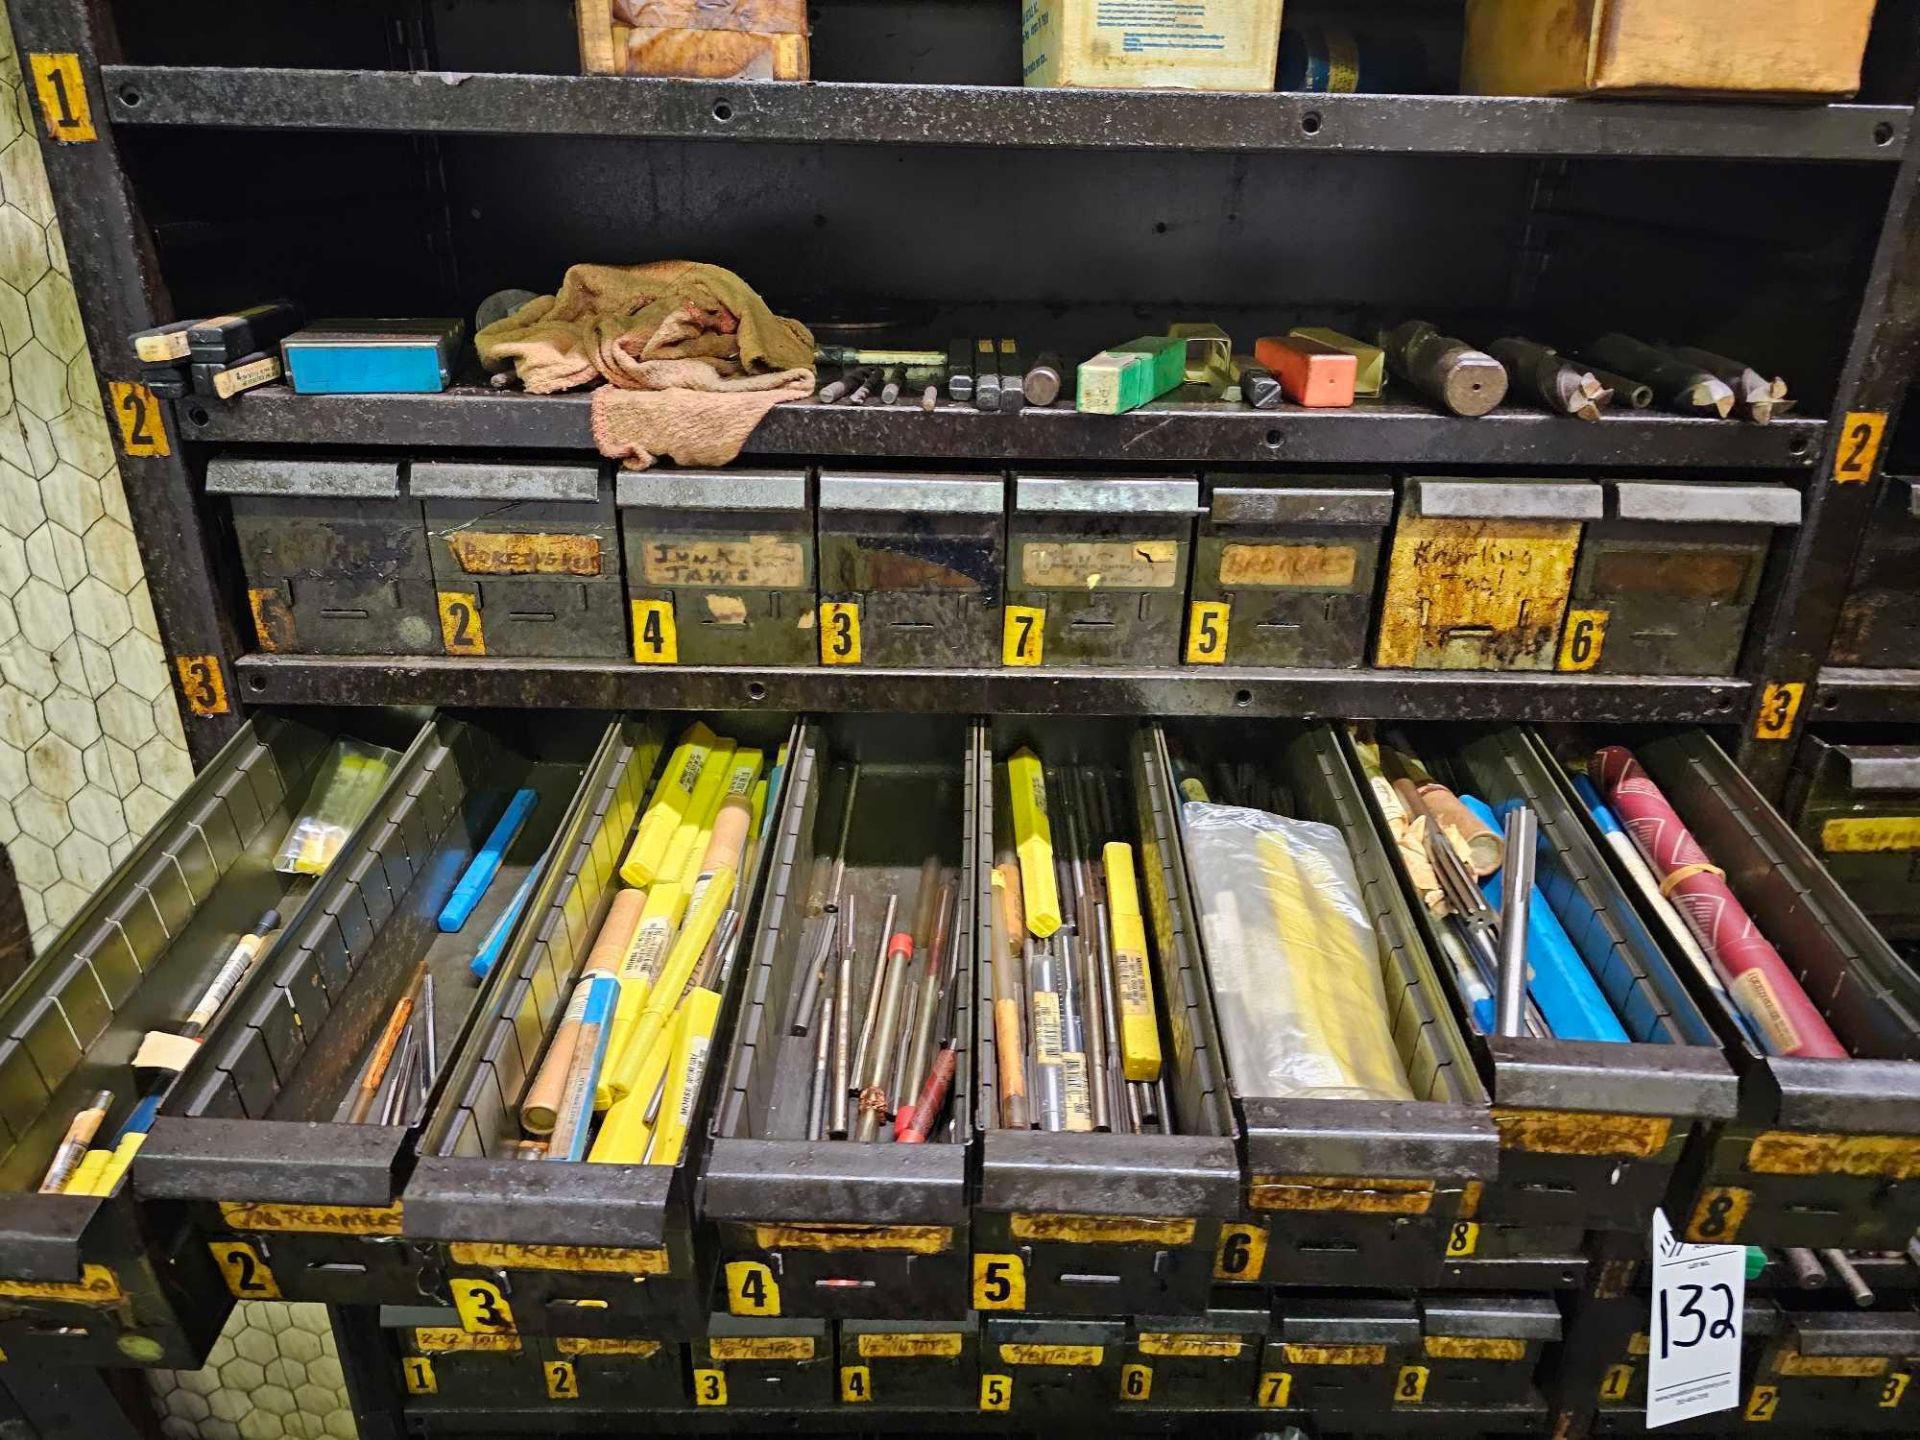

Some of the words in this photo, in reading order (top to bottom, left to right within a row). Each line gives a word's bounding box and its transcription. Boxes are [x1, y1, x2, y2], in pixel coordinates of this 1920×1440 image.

[46, 68, 80, 128] 1
[123, 391, 154, 445] 2
[1840, 423, 1872, 472] 2
[449, 603, 474, 646] 2
[643, 610, 664, 653] 4
[832, 613, 853, 656] 3
[1015, 616, 1034, 657] 7
[1199, 612, 1218, 653] 5
[1571, 620, 1592, 663] 6
[191, 663, 216, 707] 3
[1765, 689, 1793, 731] 3
[1699, 1196, 1733, 1237] 8
[1223, 1233, 1250, 1273] 6
[1451, 1223, 1468, 1251] 8
[228, 1251, 266, 1290] 2
[741, 1270, 767, 1307] 4
[984, 1263, 1011, 1301] 5
[470, 1288, 503, 1326] 3
[1660, 1283, 1736, 1359] 132
[412, 1364, 429, 1389] 1
[553, 1367, 570, 1392] 2
[704, 1376, 719, 1400] 3
[850, 1373, 864, 1396] 4
[988, 1380, 1003, 1405] 5
[1128, 1371, 1144, 1395] 6
[1268, 1378, 1283, 1402] 7
[1402, 1372, 1418, 1397] 8
[1606, 1371, 1621, 1394] 1
[1880, 1379, 1899, 1402] 3
[1752, 1392, 1773, 1416] 2
